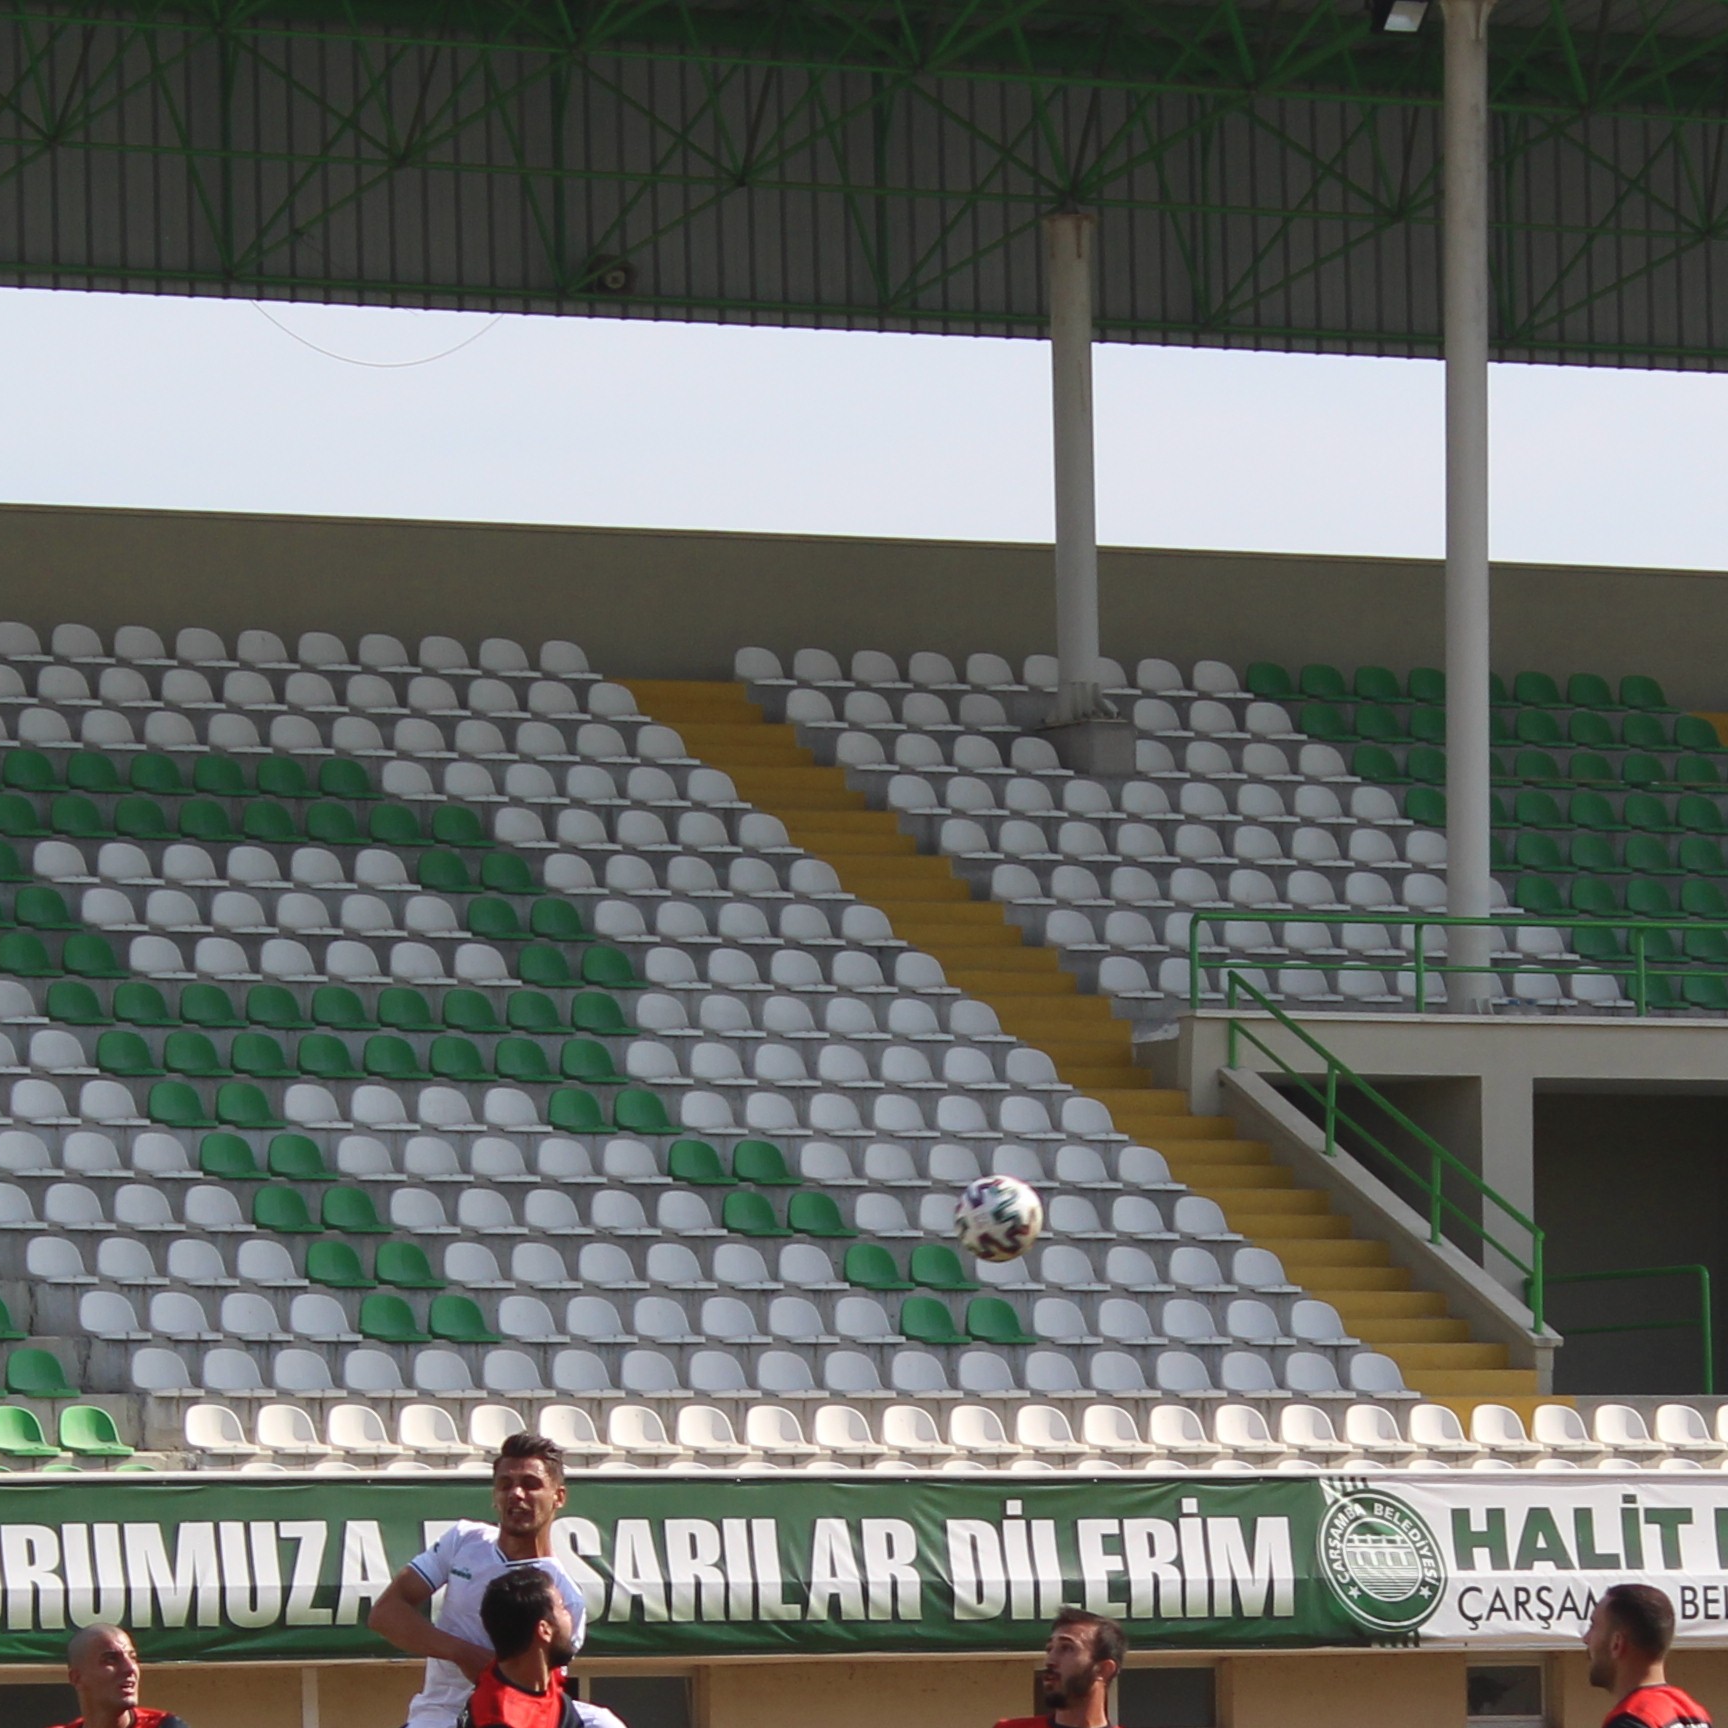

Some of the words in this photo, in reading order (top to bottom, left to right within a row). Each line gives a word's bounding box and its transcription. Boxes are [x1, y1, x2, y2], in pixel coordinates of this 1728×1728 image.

[945, 1497, 1295, 1620] DİLERİM
[1450, 1493, 1694, 1571] HALİT
[1457, 1586, 1602, 1630] ÇARŞA
